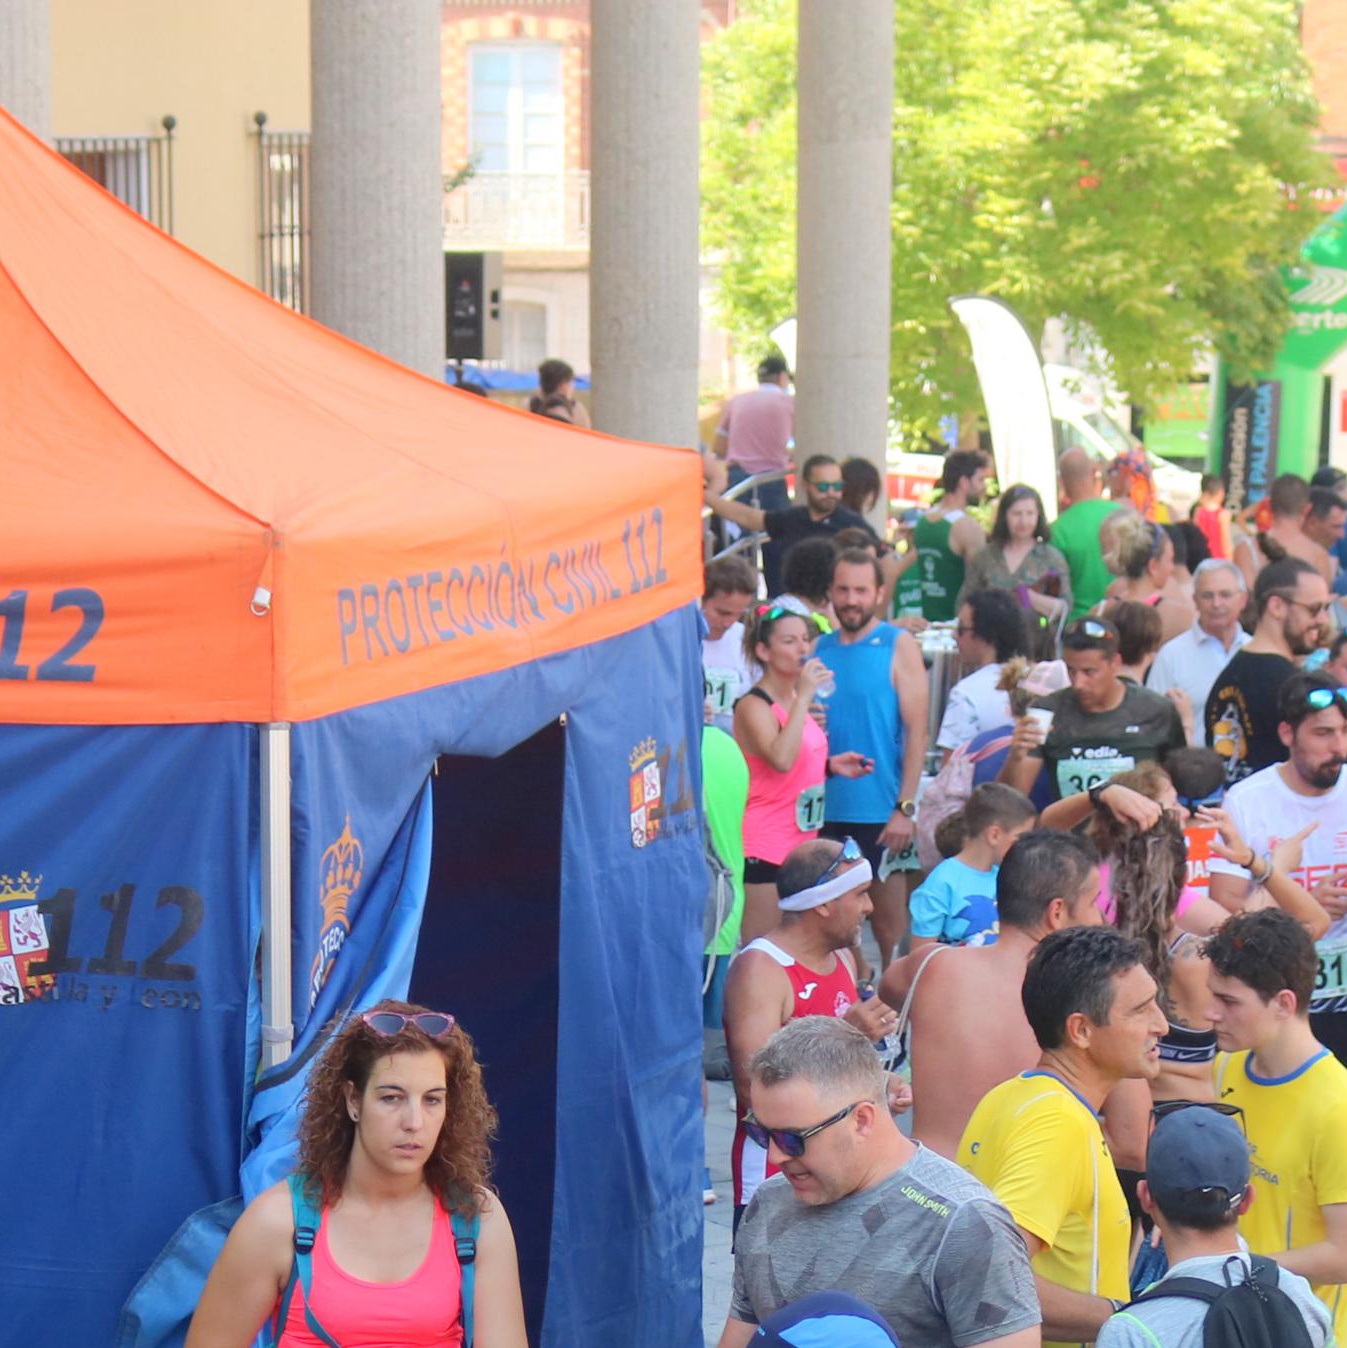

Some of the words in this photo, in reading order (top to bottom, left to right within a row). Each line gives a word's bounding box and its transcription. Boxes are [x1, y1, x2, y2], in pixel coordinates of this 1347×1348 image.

[337, 540, 547, 666] PROTECCIÓN
[543, 540, 622, 615] CIVIL
[622, 506, 668, 595] 112
[28, 883, 205, 982] 112
[900, 1185, 928, 1206] JOHN
[923, 1199, 951, 1219] SMITH
